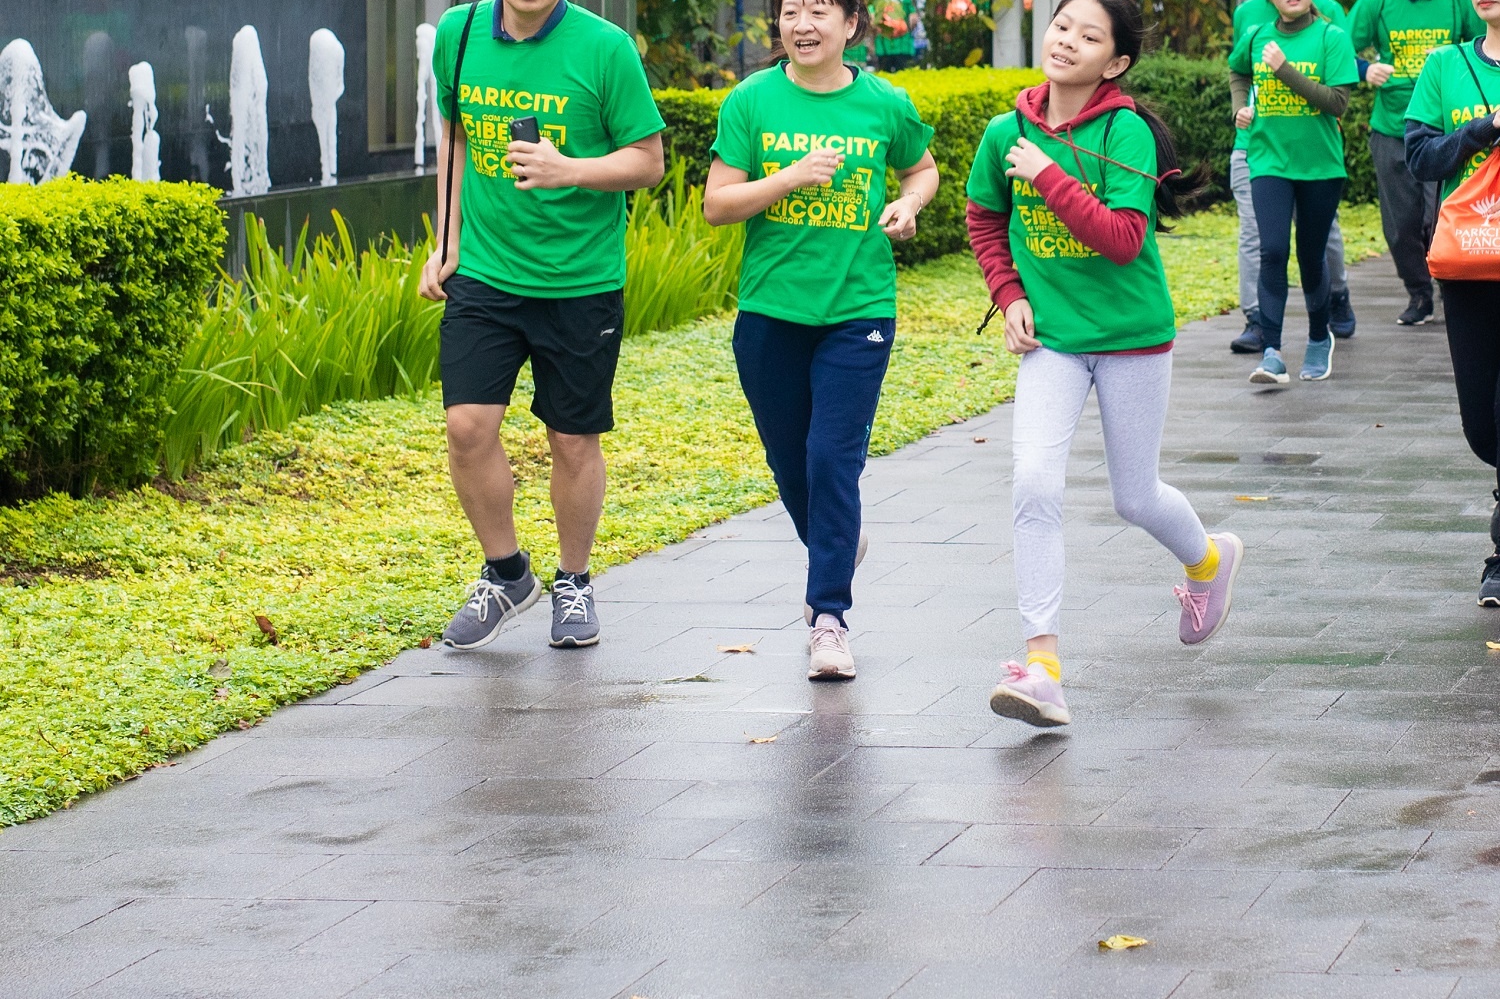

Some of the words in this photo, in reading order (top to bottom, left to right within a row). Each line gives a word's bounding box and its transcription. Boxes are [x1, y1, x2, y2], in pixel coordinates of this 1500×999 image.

[1390, 29, 1450, 41] PARKCITY
[460, 84, 569, 114] PARKCITY
[463, 118, 512, 142] CIBE
[762, 132, 879, 158] PARKCITY
[471, 147, 512, 173] RICO
[770, 198, 857, 224] RICONS
[1020, 209, 1066, 227] CIBE
